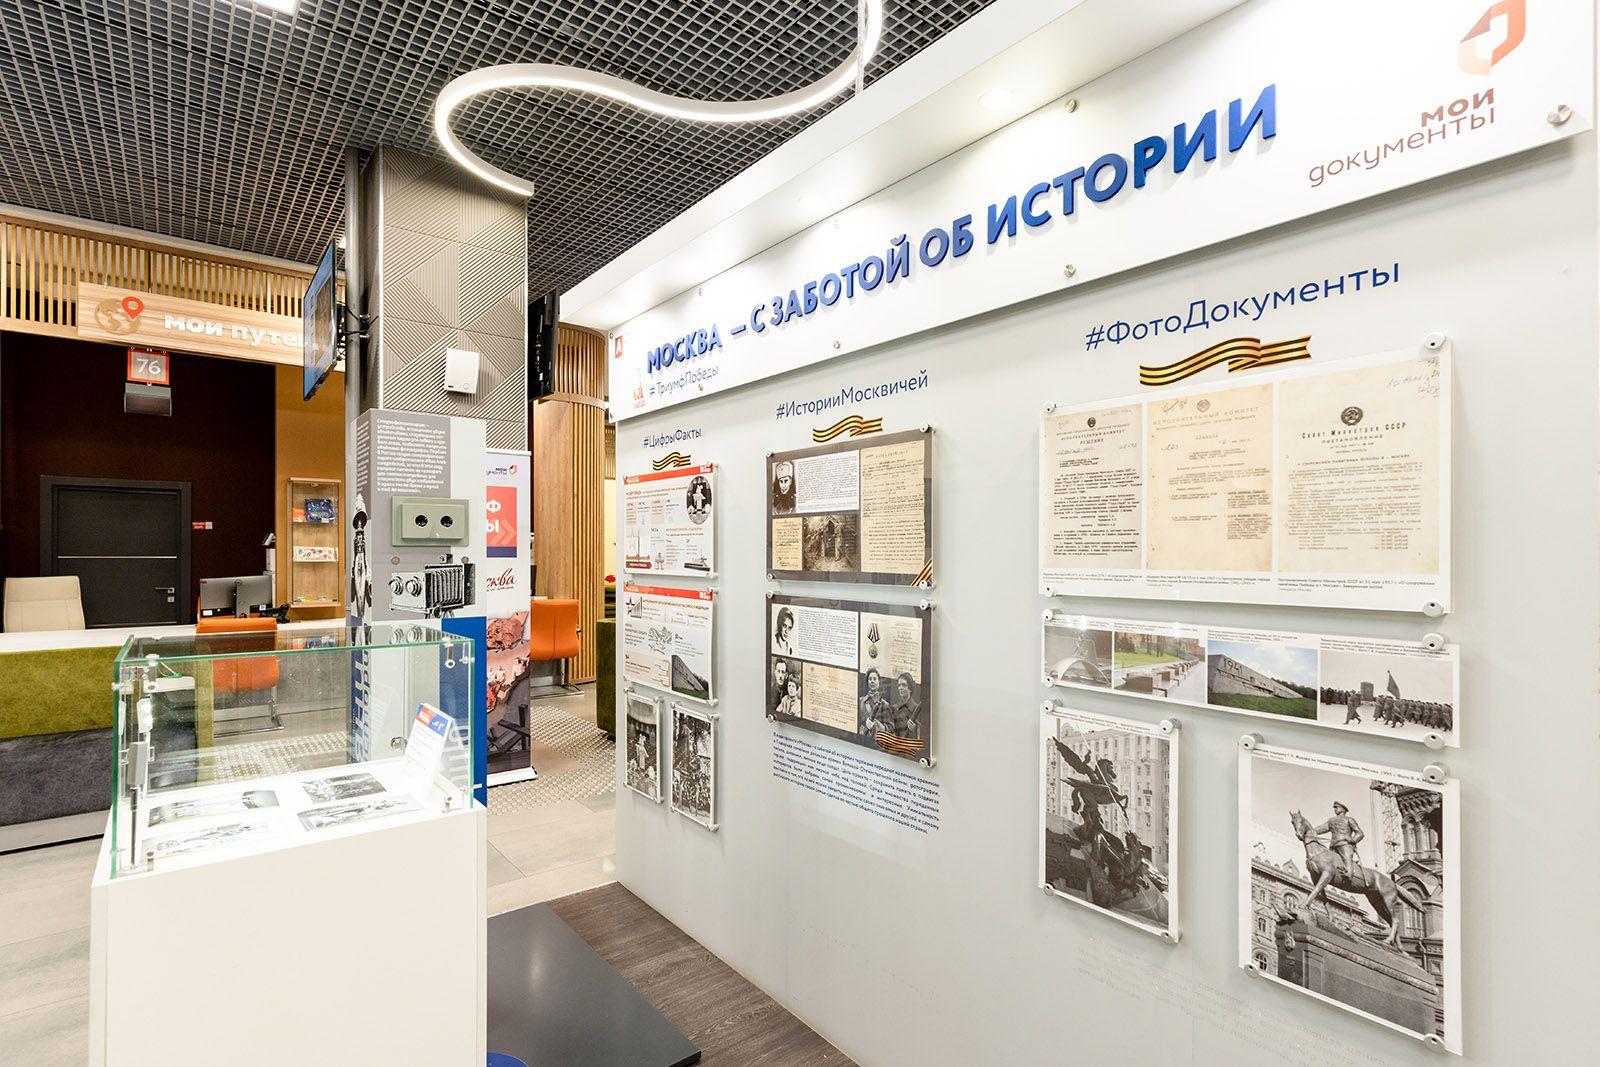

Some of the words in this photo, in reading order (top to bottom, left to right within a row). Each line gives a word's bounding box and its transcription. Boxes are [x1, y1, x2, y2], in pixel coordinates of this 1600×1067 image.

[1421, 88, 1495, 127] мои
[1309, 107, 1495, 187] документы
[647, 322, 722, 373] МОСКВА
[751, 304, 766, 333] С
[770, 234, 910, 327] ЗАБОТОЙ
[919, 213, 975, 267] ОБ
[987, 84, 1277, 245] ИСТОРИИ
[164, 314, 223, 337] мои
[1085, 262, 1399, 351] #ФотоДокументы
[137, 358, 161, 375] 76
[776, 369, 928, 420] #ИсторииМосквичей
[643, 428, 702, 448] #ЦифрыФакты
[1385, 422, 1406, 430] СССР
